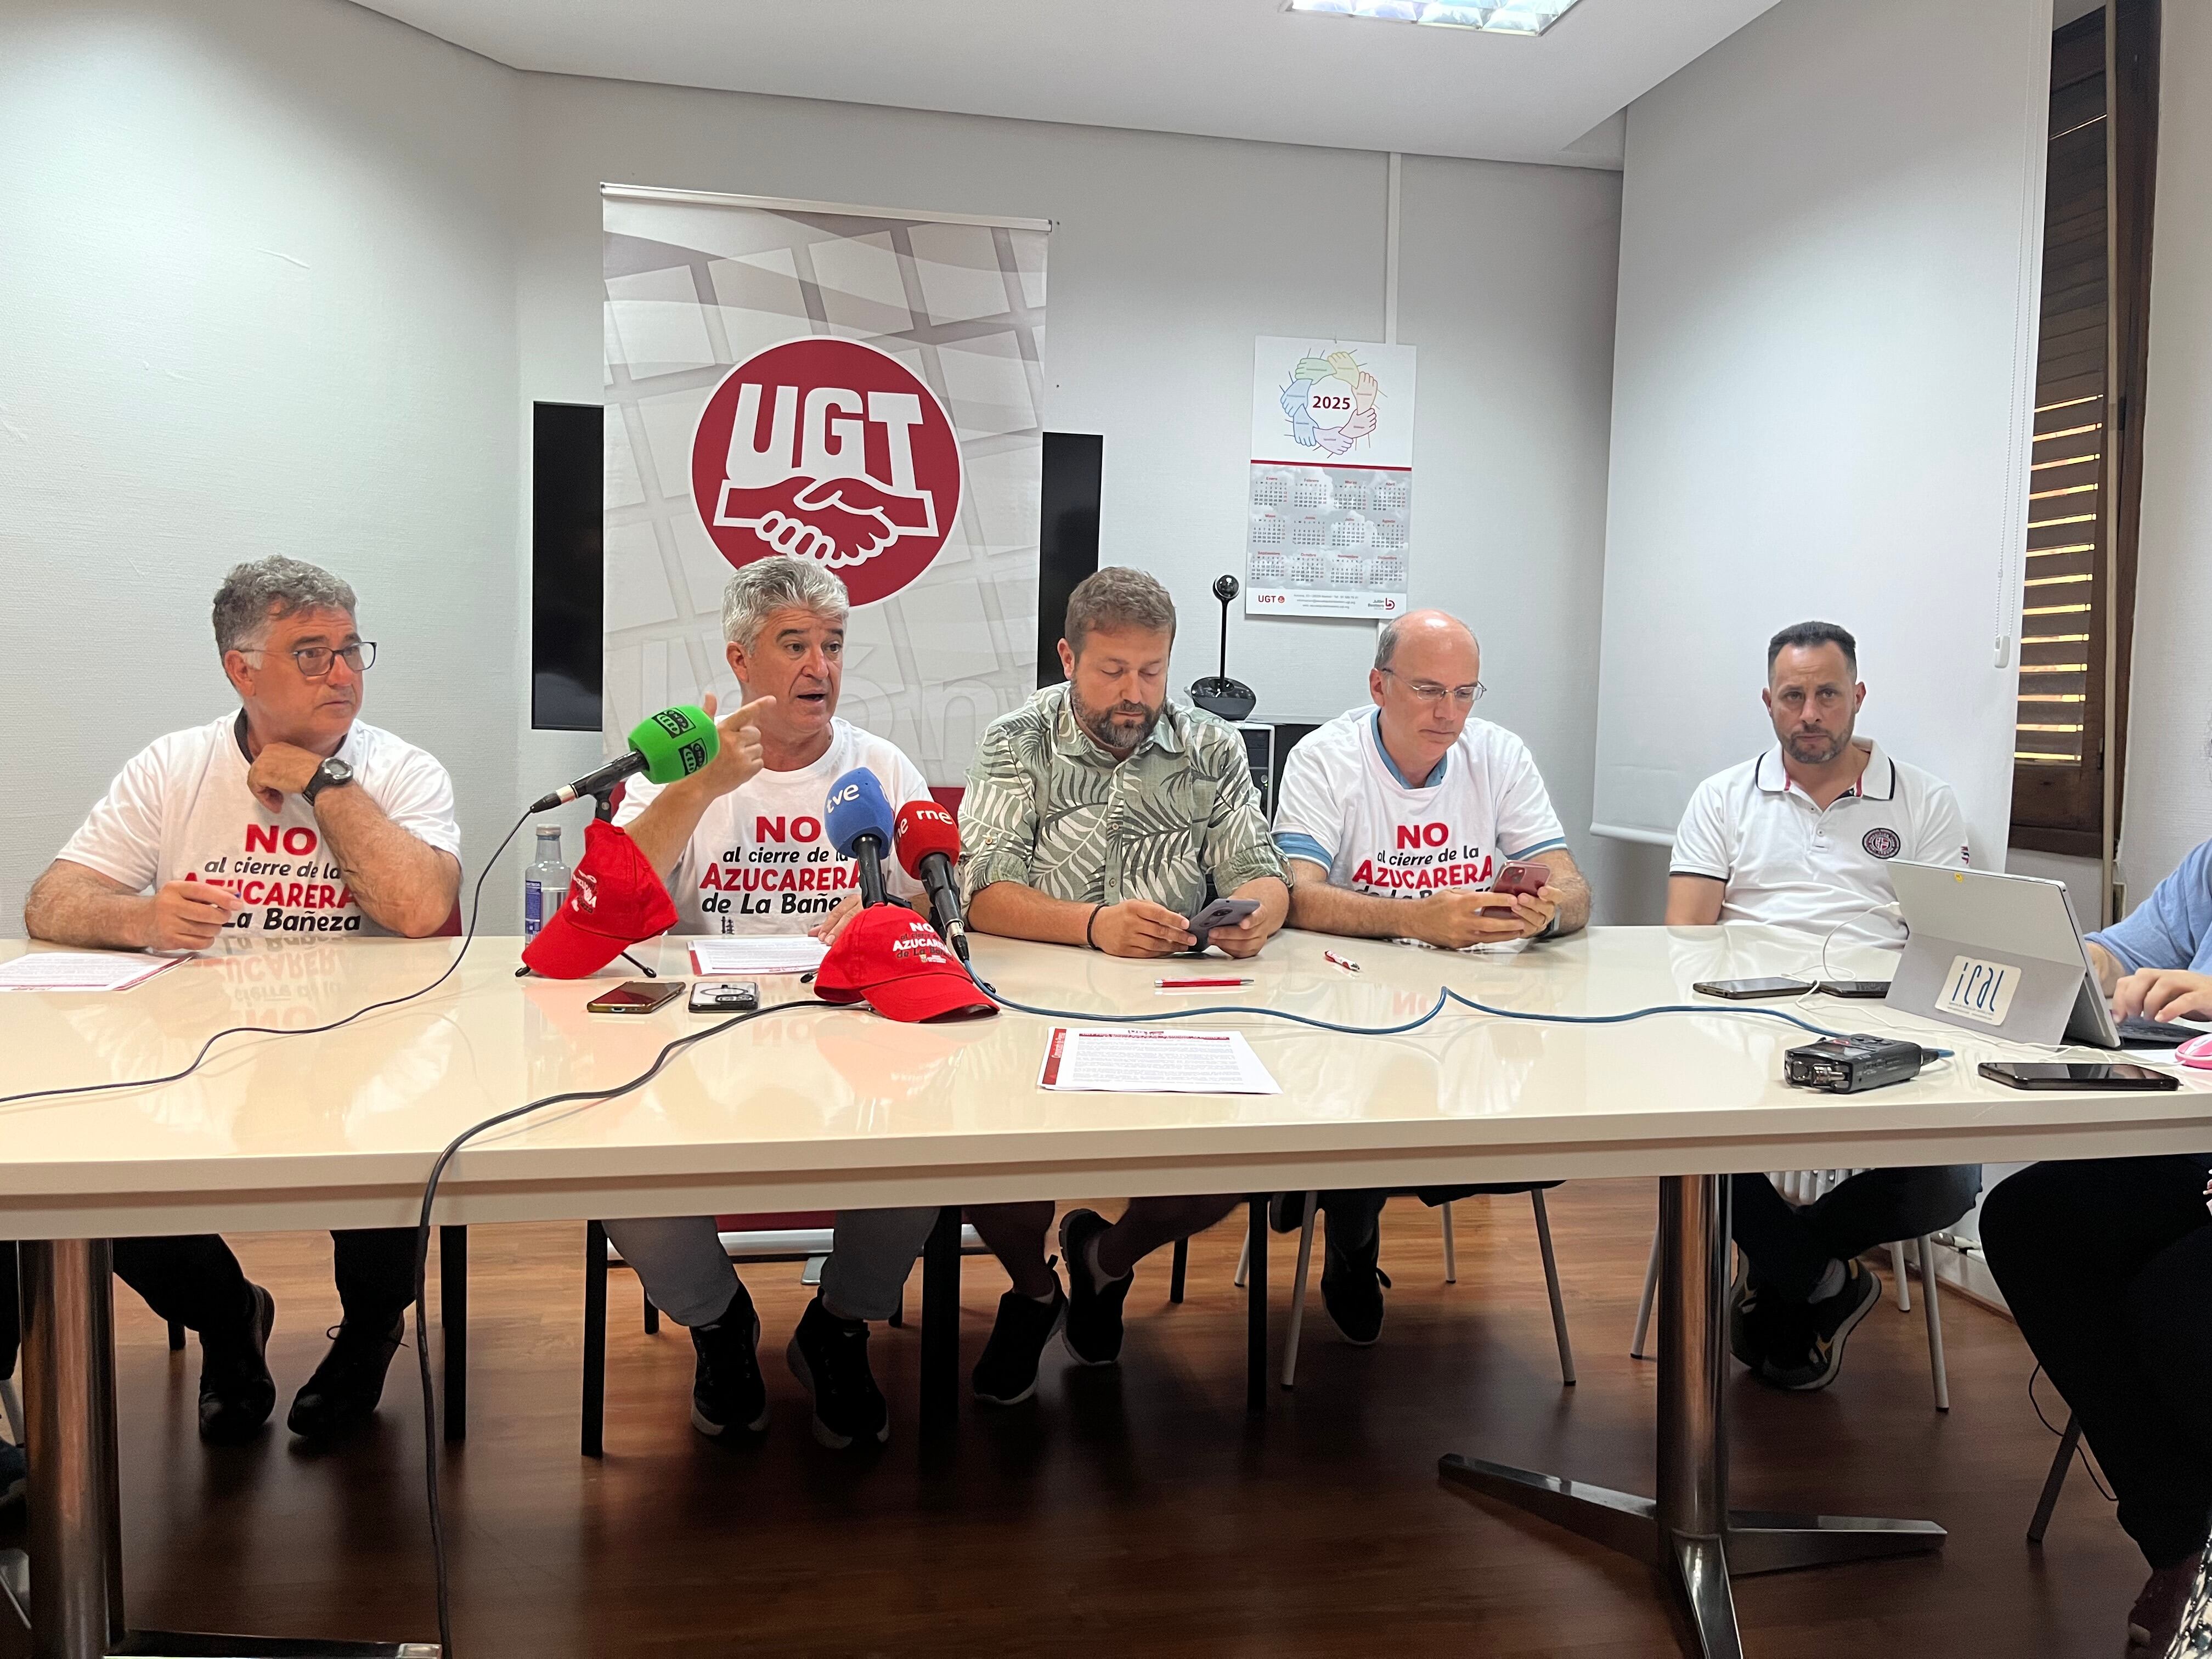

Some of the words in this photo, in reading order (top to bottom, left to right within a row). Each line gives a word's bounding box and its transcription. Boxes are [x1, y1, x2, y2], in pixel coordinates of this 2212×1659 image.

[1313, 396, 1351, 410] 2025
[726, 383, 923, 492] UGT
[659, 715, 678, 732] CERO
[826, 784, 860, 814] tve
[916, 810, 953, 825] rne
[245, 824, 318, 856] NO
[756, 816, 821, 843] NO
[1397, 822, 1449, 850] NO
[723, 847, 741, 863] al
[748, 847, 800, 863] cierre
[807, 847, 830, 862] de
[1377, 850, 1386, 862] al
[1389, 851, 1433, 866] cierre
[1438, 848, 1457, 862] de
[1463, 845, 1479, 859] la
[204, 857, 228, 873] al
[234, 856, 291, 877] cierre
[297, 861, 318, 878] de
[323, 863, 341, 879] la
[699, 863, 861, 893] AZUCARERA
[1352, 855, 1492, 889] AZUCARERA
[702, 893, 731, 913] de
[741, 893, 771, 915] La
[781, 893, 847, 915] Bañe
[263, 908, 361, 932] Bañeza
[909, 922, 935, 933] NO
[897, 950, 909, 958] de
[913, 948, 926, 956] La
